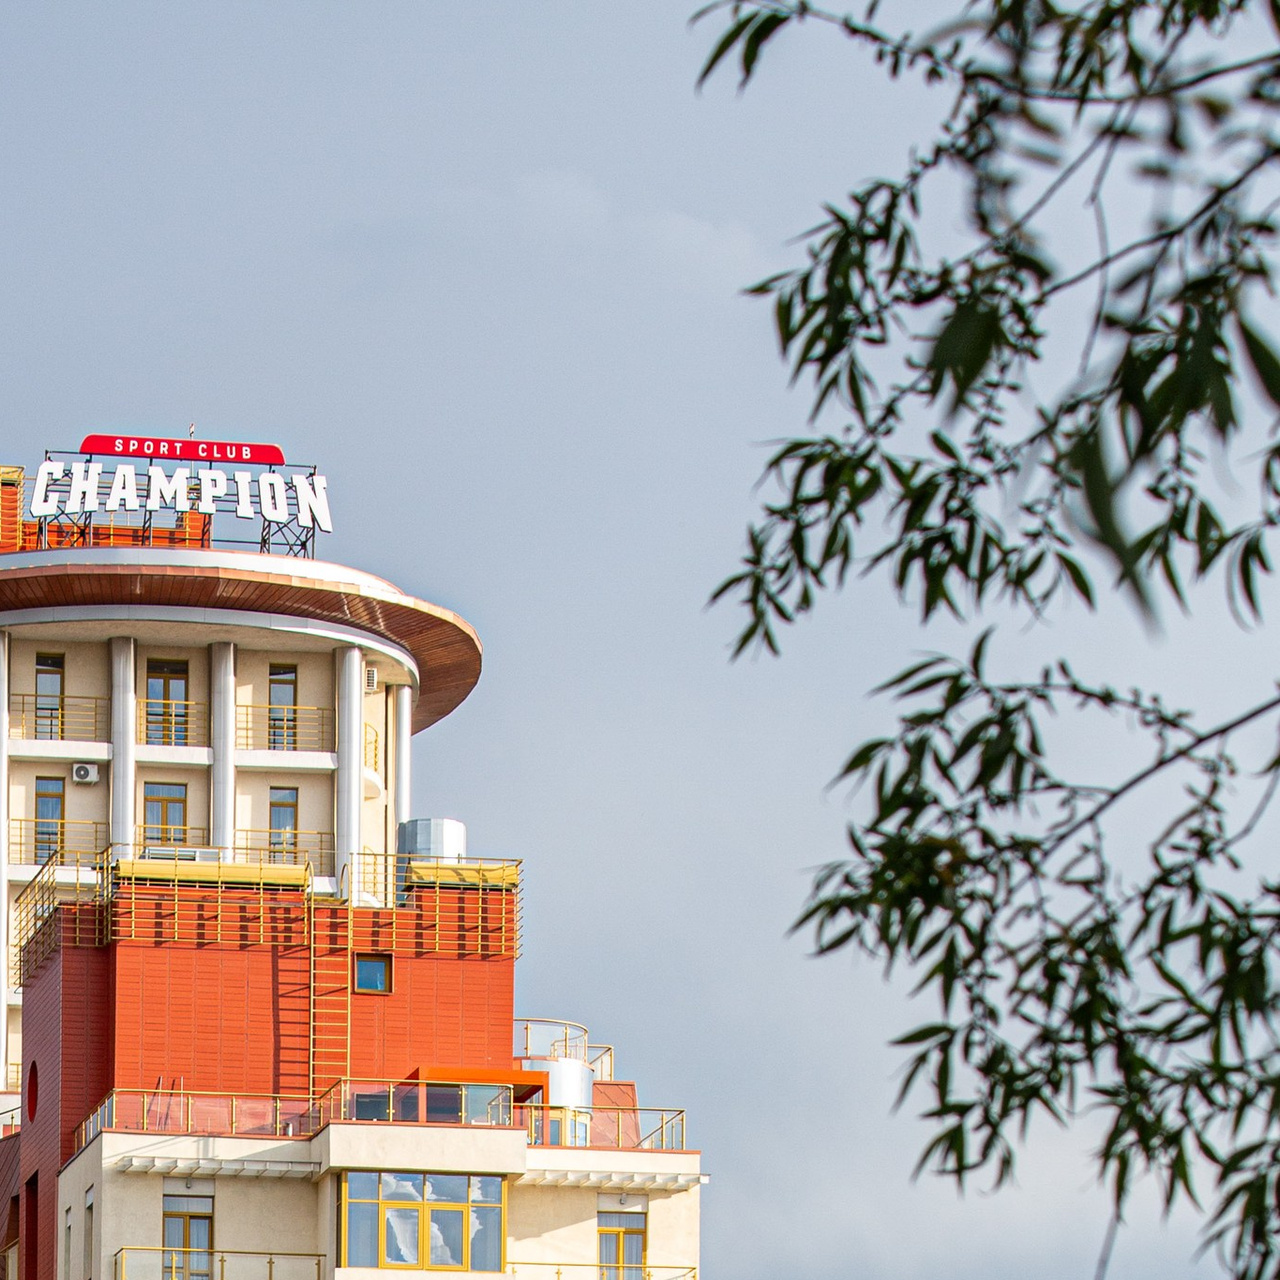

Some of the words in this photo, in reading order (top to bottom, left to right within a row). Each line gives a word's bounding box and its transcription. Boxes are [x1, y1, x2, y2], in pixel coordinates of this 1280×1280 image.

[114, 439, 183, 456] SPORT
[198, 443, 252, 460] CLUB
[30, 461, 333, 533] CHAMPION
